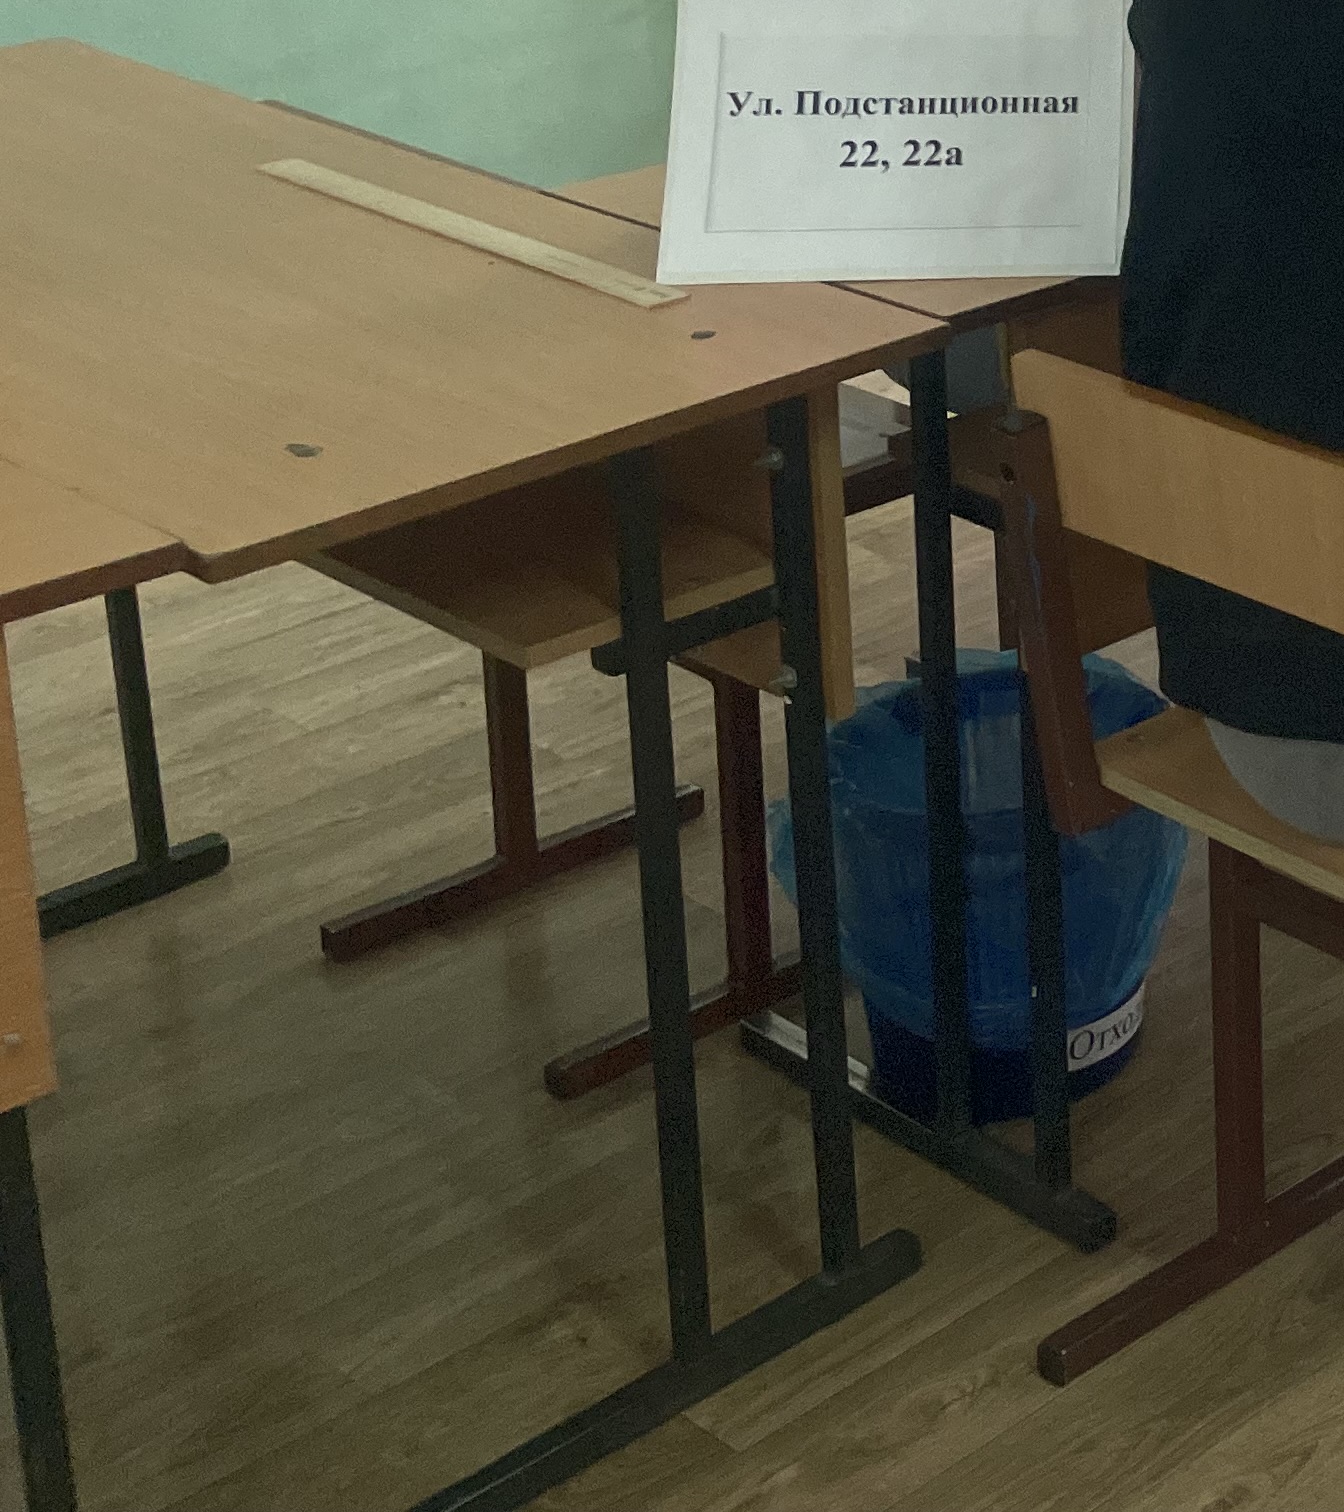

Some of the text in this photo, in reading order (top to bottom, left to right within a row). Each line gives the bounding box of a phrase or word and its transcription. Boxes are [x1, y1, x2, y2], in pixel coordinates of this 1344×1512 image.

[727, 90, 1080, 119] Ул. Подстанционная
[839, 139, 964, 174] 22, 22а
